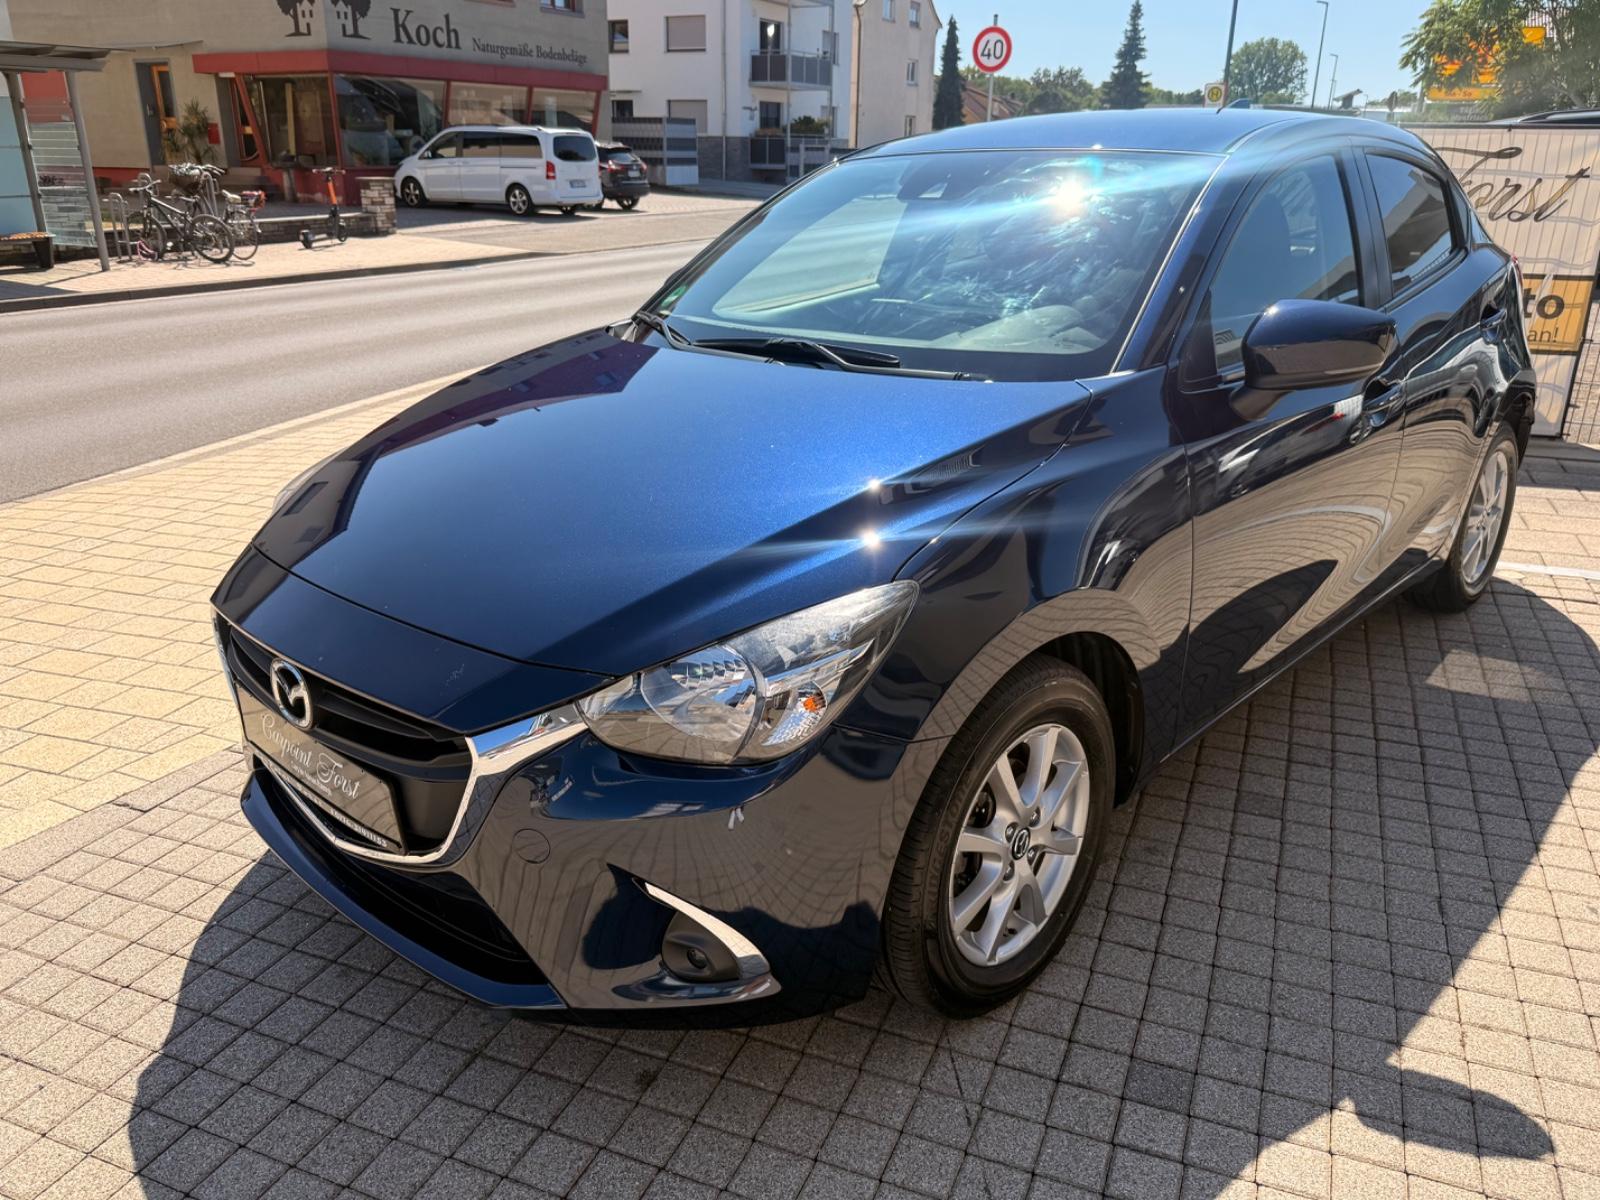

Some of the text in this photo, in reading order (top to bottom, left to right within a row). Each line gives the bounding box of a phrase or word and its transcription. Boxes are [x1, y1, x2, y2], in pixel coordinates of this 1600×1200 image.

[390, 7, 461, 49] Koch
[472, 37, 588, 66] Naturgemäße Bodenbeläge
[980, 39, 1004, 60] 40
[262, 714, 312, 768] Carpoint
[316, 752, 361, 799] Forst
